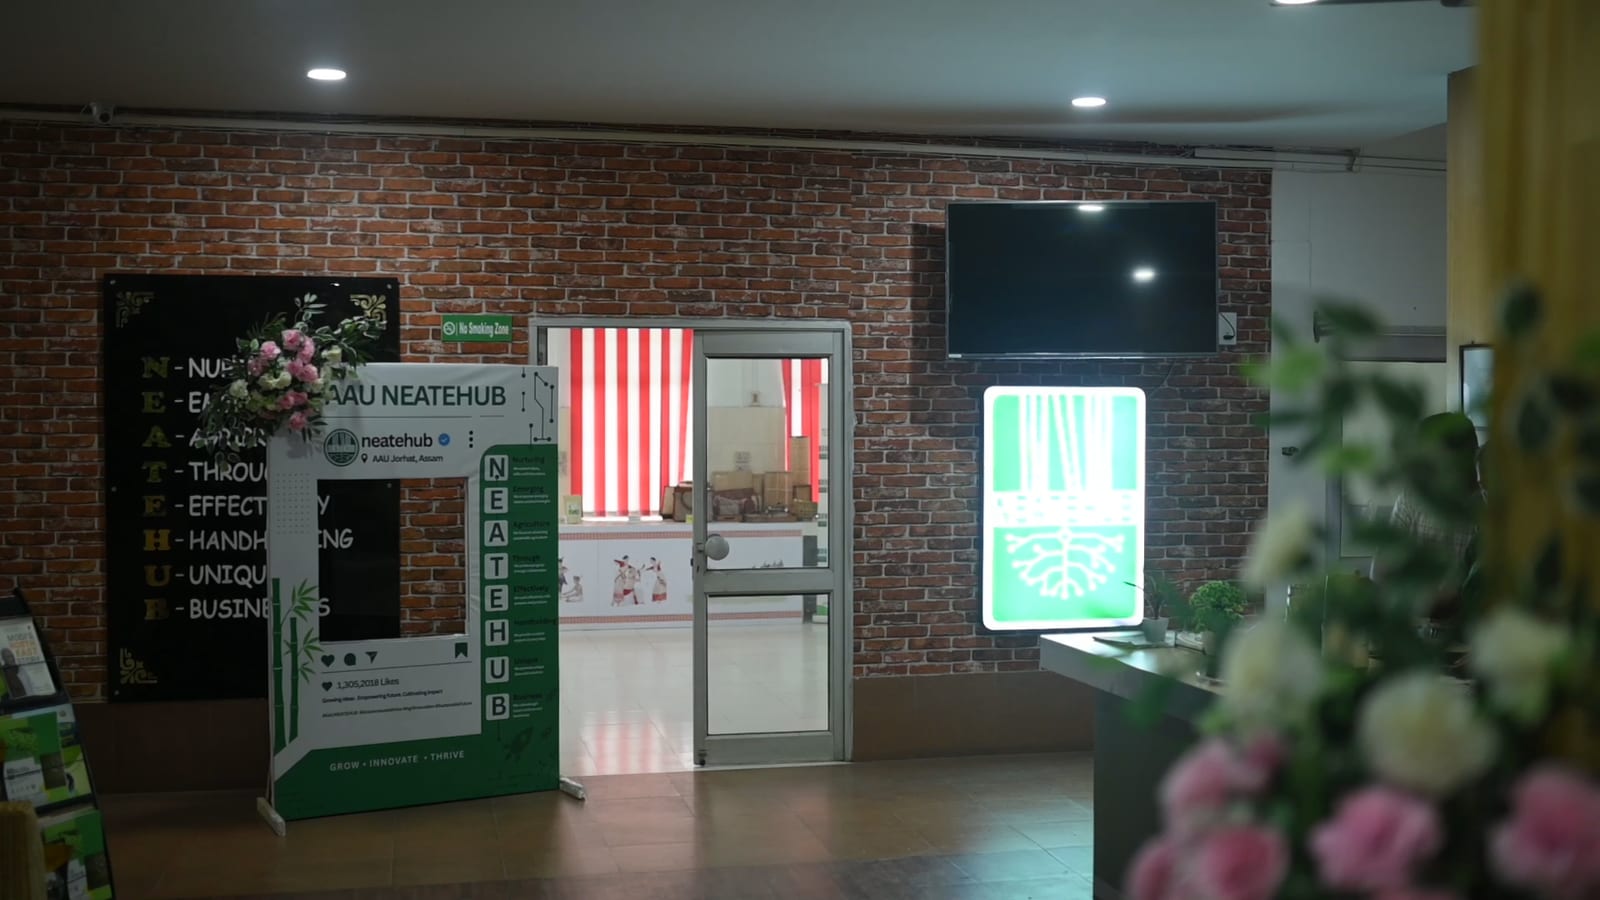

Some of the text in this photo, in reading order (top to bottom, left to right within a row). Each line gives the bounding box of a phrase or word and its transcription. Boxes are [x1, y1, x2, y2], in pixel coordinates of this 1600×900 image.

[458, 322, 509, 338] No Smoking Zone
[325, 384, 506, 406] AAU NEATEHUB
[361, 433, 433, 448] neatehub
[372, 454, 444, 464] AAU Jorhat, Assam
[490, 458, 505, 477] N
[188, 461, 268, 482] THROU
[491, 490, 503, 509] E
[489, 523, 505, 542] A
[490, 557, 504, 576] T
[189, 564, 267, 589] UNIQU
[491, 589, 503, 608] E
[490, 622, 505, 642] H
[490, 660, 505, 679] U
[380, 678, 400, 686] Likes
[492, 696, 506, 716] B
[329, 750, 465, 771] GROW INNOVATE THRIVE
